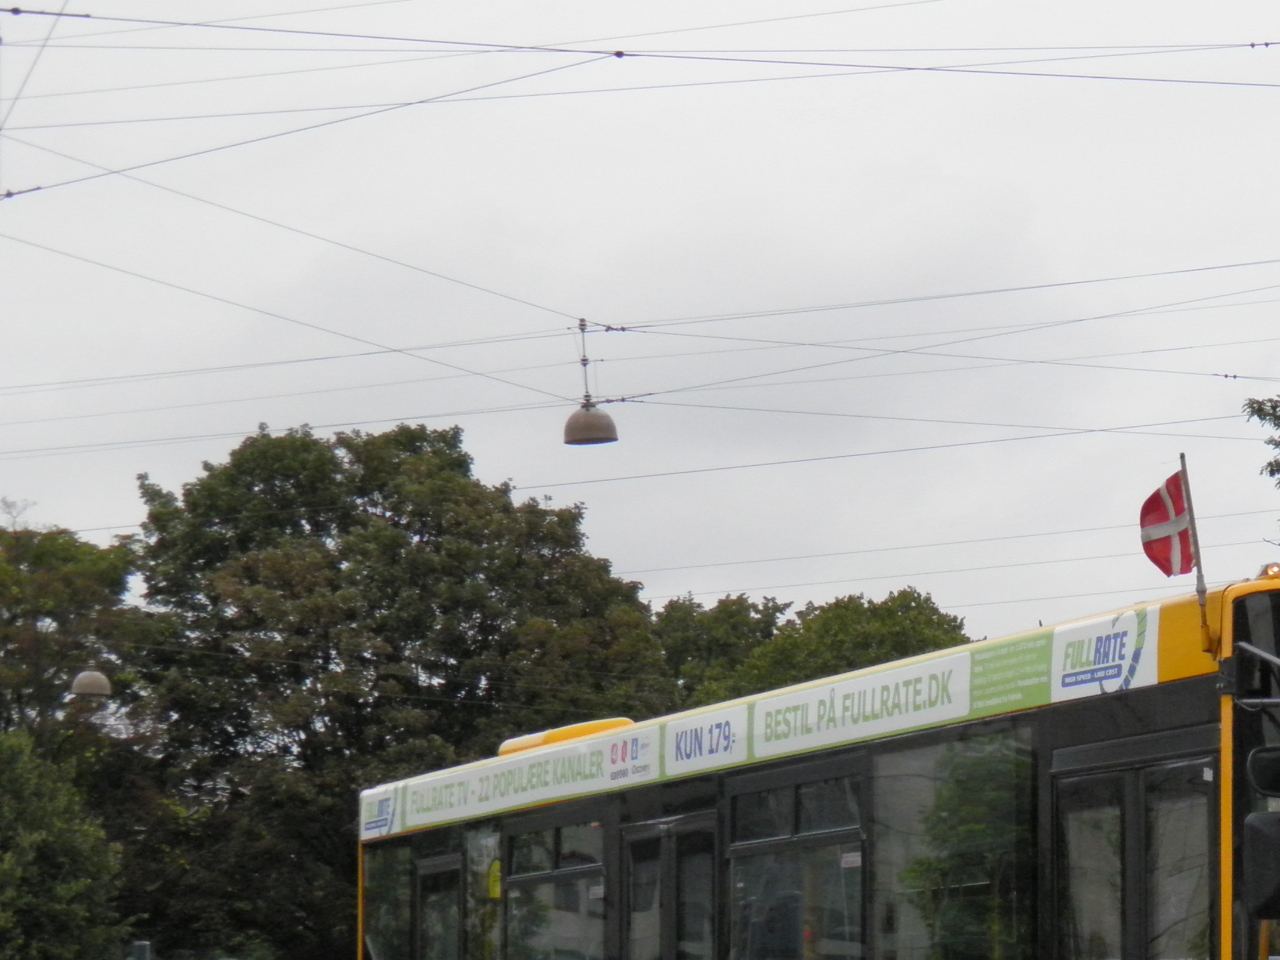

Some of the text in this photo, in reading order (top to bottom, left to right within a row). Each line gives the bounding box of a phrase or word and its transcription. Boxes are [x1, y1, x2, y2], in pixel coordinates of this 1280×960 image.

[1062, 630, 1128, 671] FULLRATE
[1076, 673, 1092, 682] SPEED
[1105, 668, 1118, 676] COST
[764, 702, 813, 742] BESTIL
[817, 687, 837, 731] PÅ
[841, 669, 954, 727] FULLRATE.DK
[675, 726, 704, 762] KUN
[411, 782, 456, 815] FULLRATE
[457, 780, 470, 807] TV
[478, 775, 490, 803] 22
[492, 760, 550, 800] POPULÆRE
[552, 749, 604, 785] KANALER
